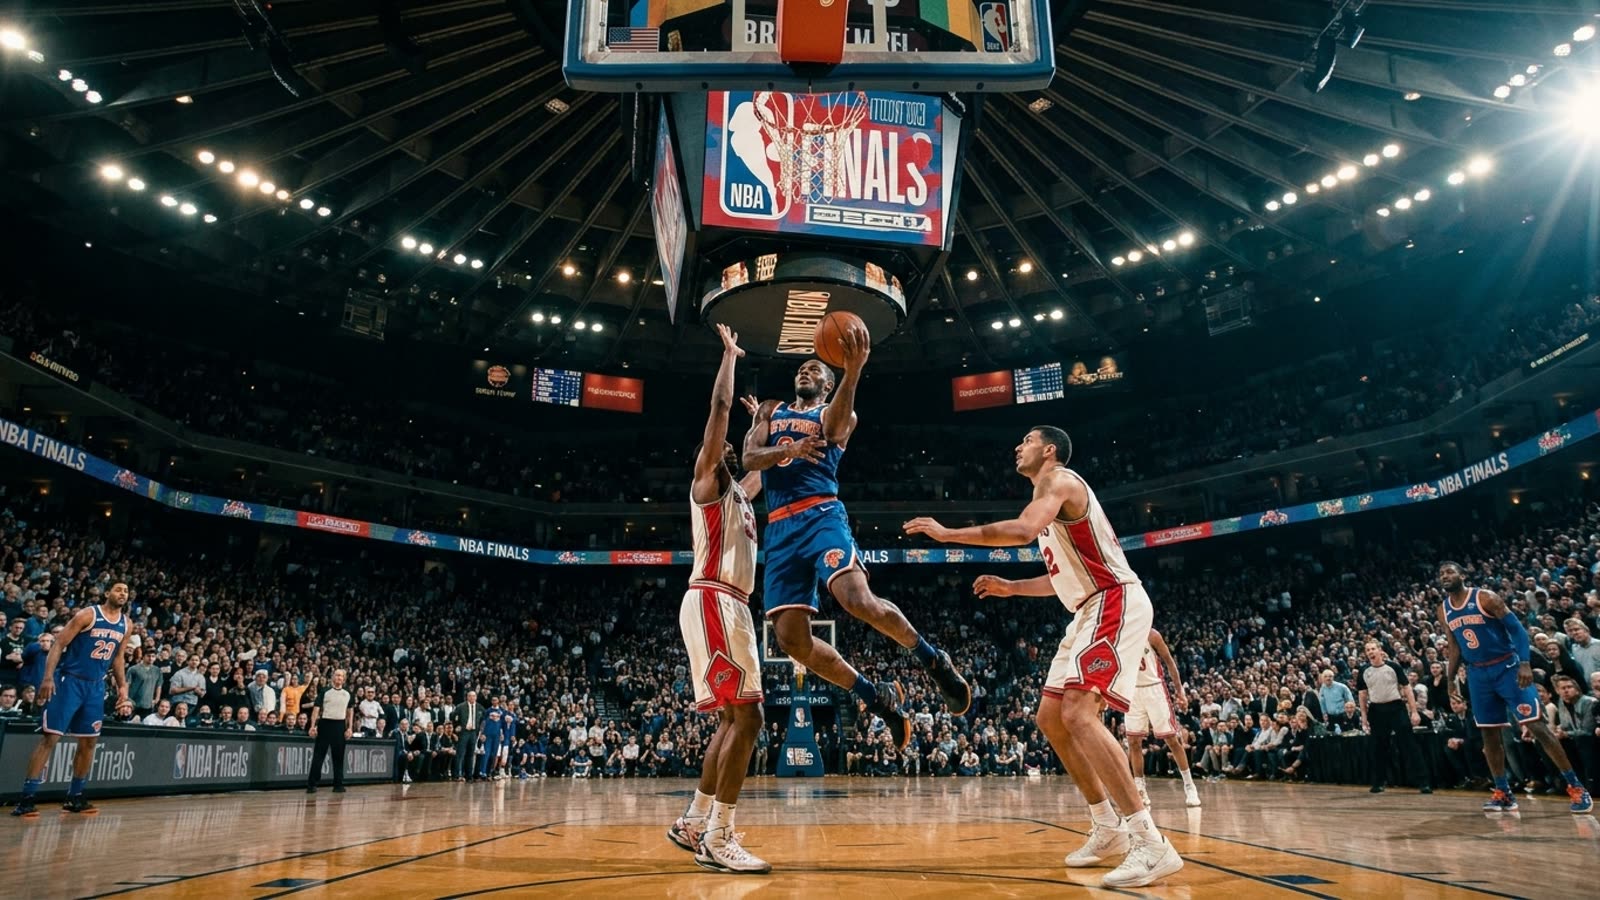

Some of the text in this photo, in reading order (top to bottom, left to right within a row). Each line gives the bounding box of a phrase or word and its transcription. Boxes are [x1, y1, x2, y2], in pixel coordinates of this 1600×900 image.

[730, 182, 765, 210] NBA
[0, 419, 87, 471] NBA FINALS
[1438, 474, 1464, 497] NBA
[1463, 452, 1509, 486] FINALS
[459, 538, 530, 561] NBA FINALS
[863, 551, 888, 563] ALS
[1462, 628, 1480, 649] 9
[49, 742, 136, 783] NB Finals
[185, 744, 249, 778] NBA Finals
